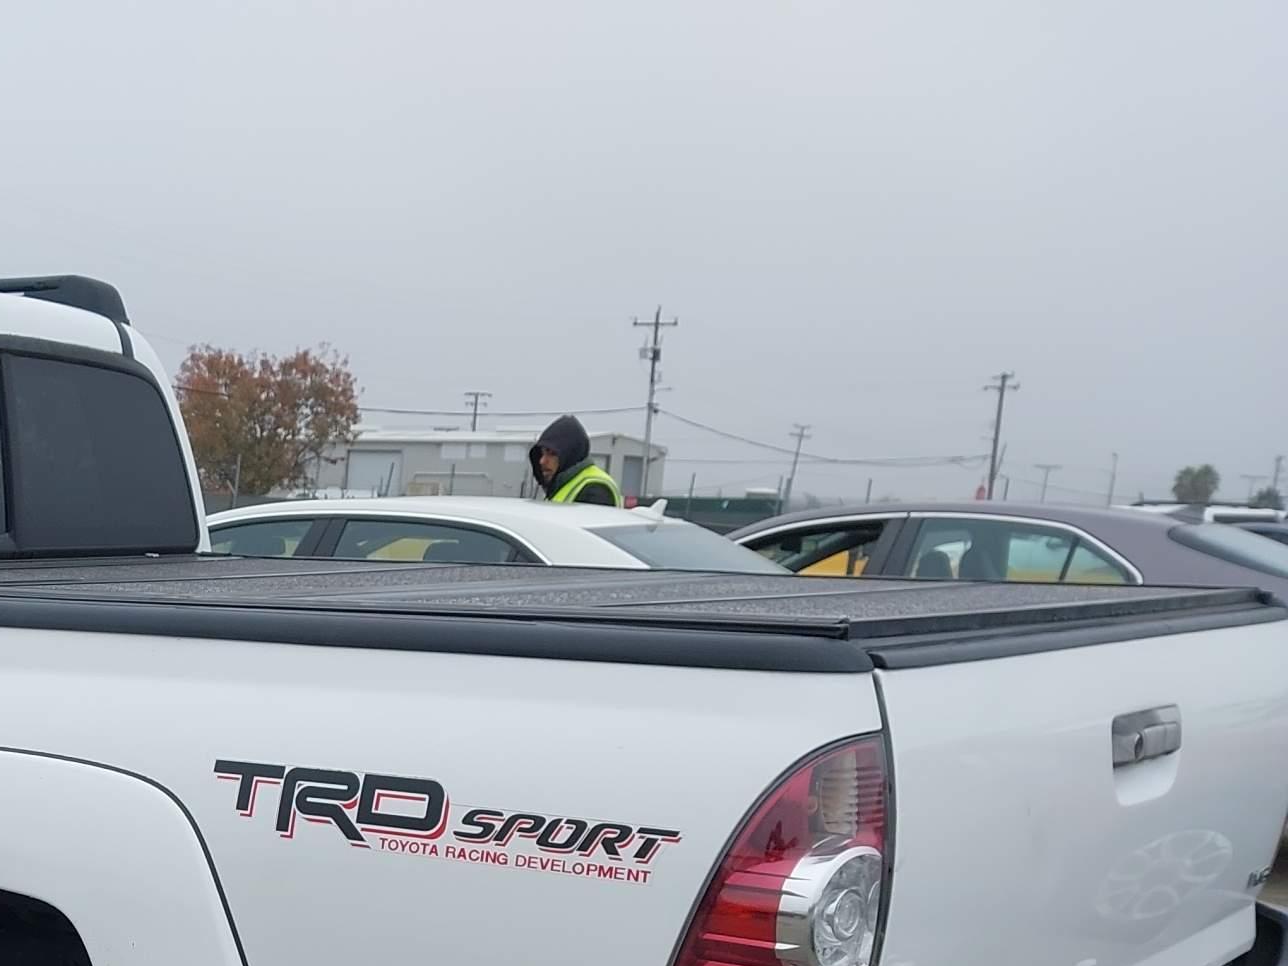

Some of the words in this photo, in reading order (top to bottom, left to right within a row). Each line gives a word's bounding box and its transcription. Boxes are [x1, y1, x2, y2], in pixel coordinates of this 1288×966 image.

[213, 759, 449, 848] TRD
[453, 808, 682, 865] SPORT
[379, 837, 439, 857] TOYOTA
[445, 845, 509, 866] RACING
[514, 854, 652, 884] DEVELOPMENT
